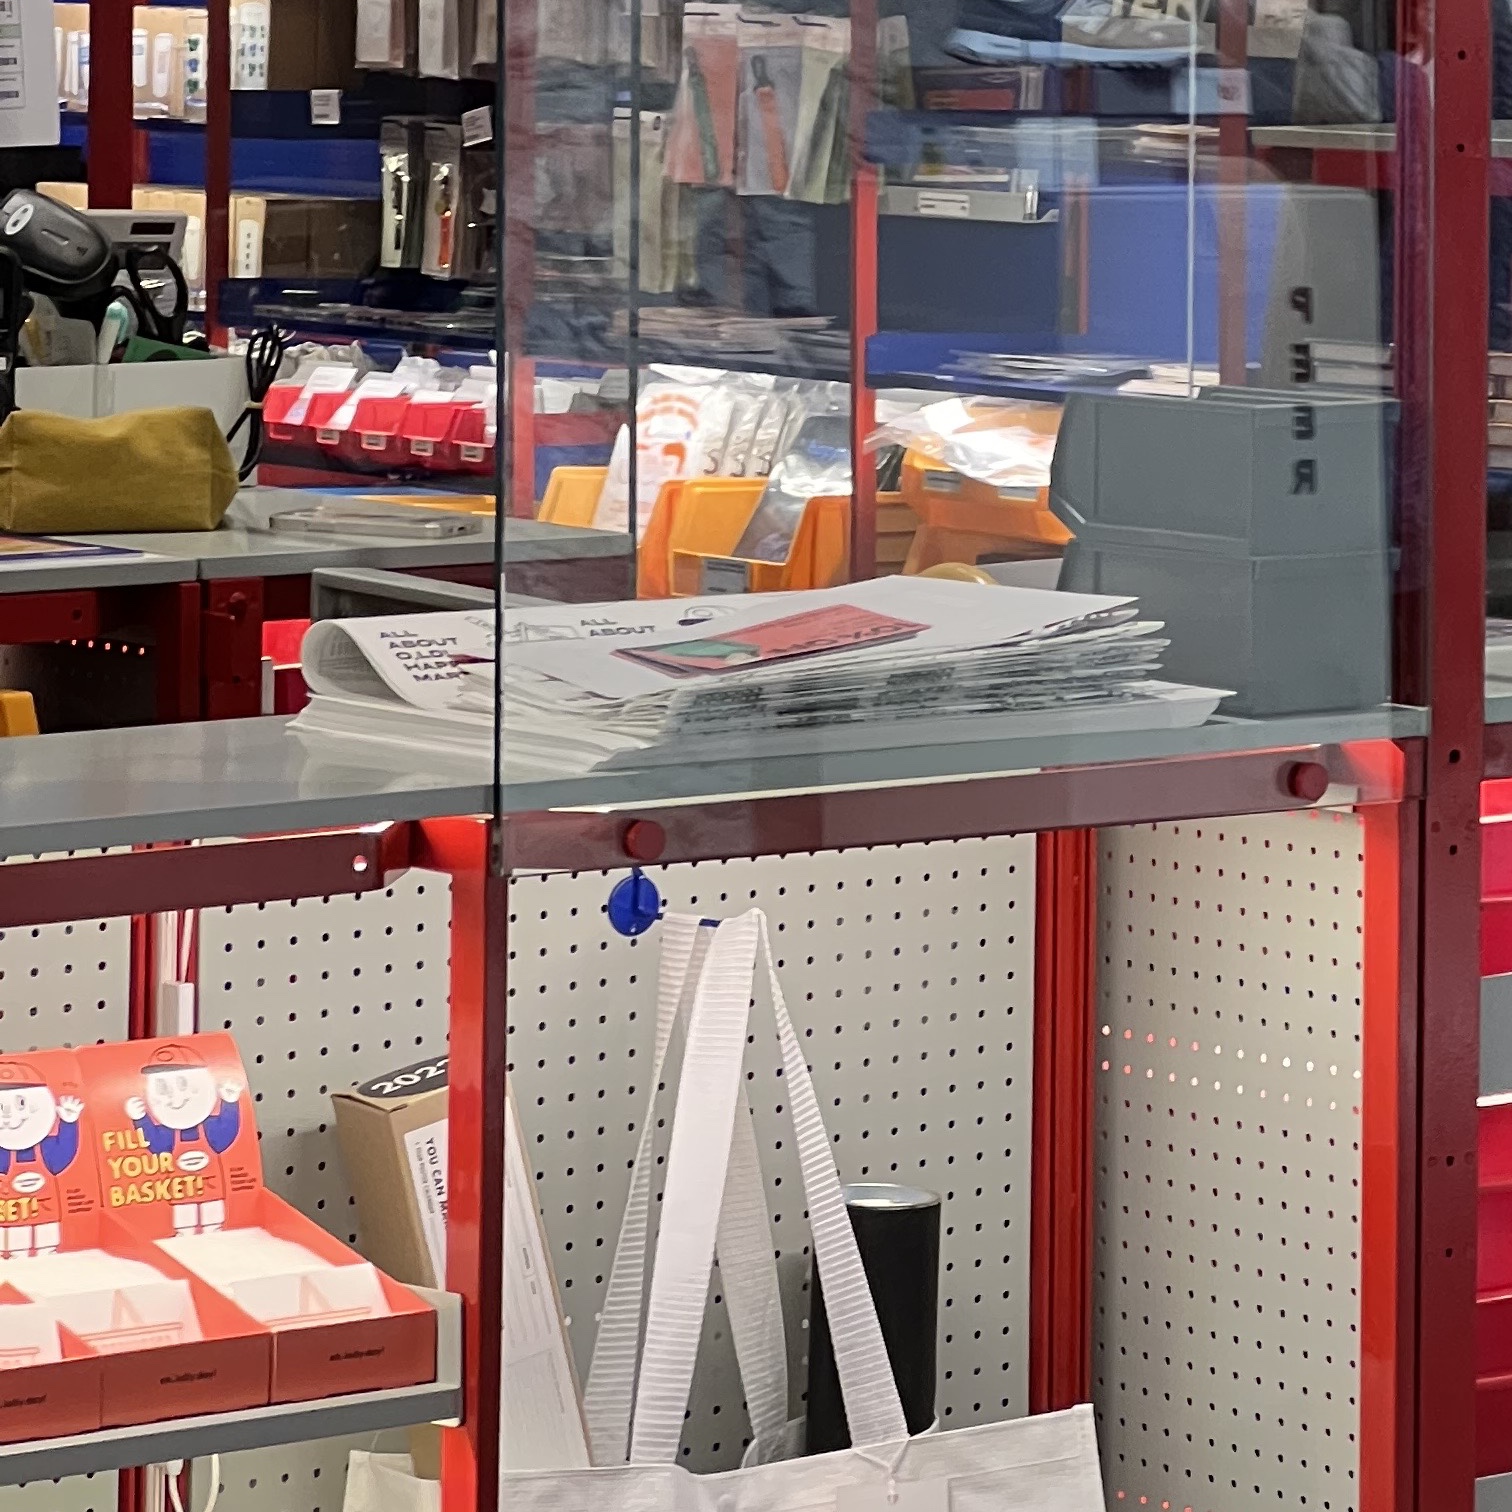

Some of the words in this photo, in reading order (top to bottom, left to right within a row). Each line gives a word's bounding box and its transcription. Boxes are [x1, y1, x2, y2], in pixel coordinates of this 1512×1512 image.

[380, 630, 418, 639] ALL
[580, 618, 617, 626] ALL
[589, 625, 656, 637] ABOUT
[389, 637, 457, 649] ABOUT
[102, 1127, 150, 1152] FILL
[425, 1137, 440, 1166] YOU
[107, 1152, 174, 1179] YOUR
[110, 1175, 204, 1207] BASKET!
[432, 1169, 446, 1197] CAN
